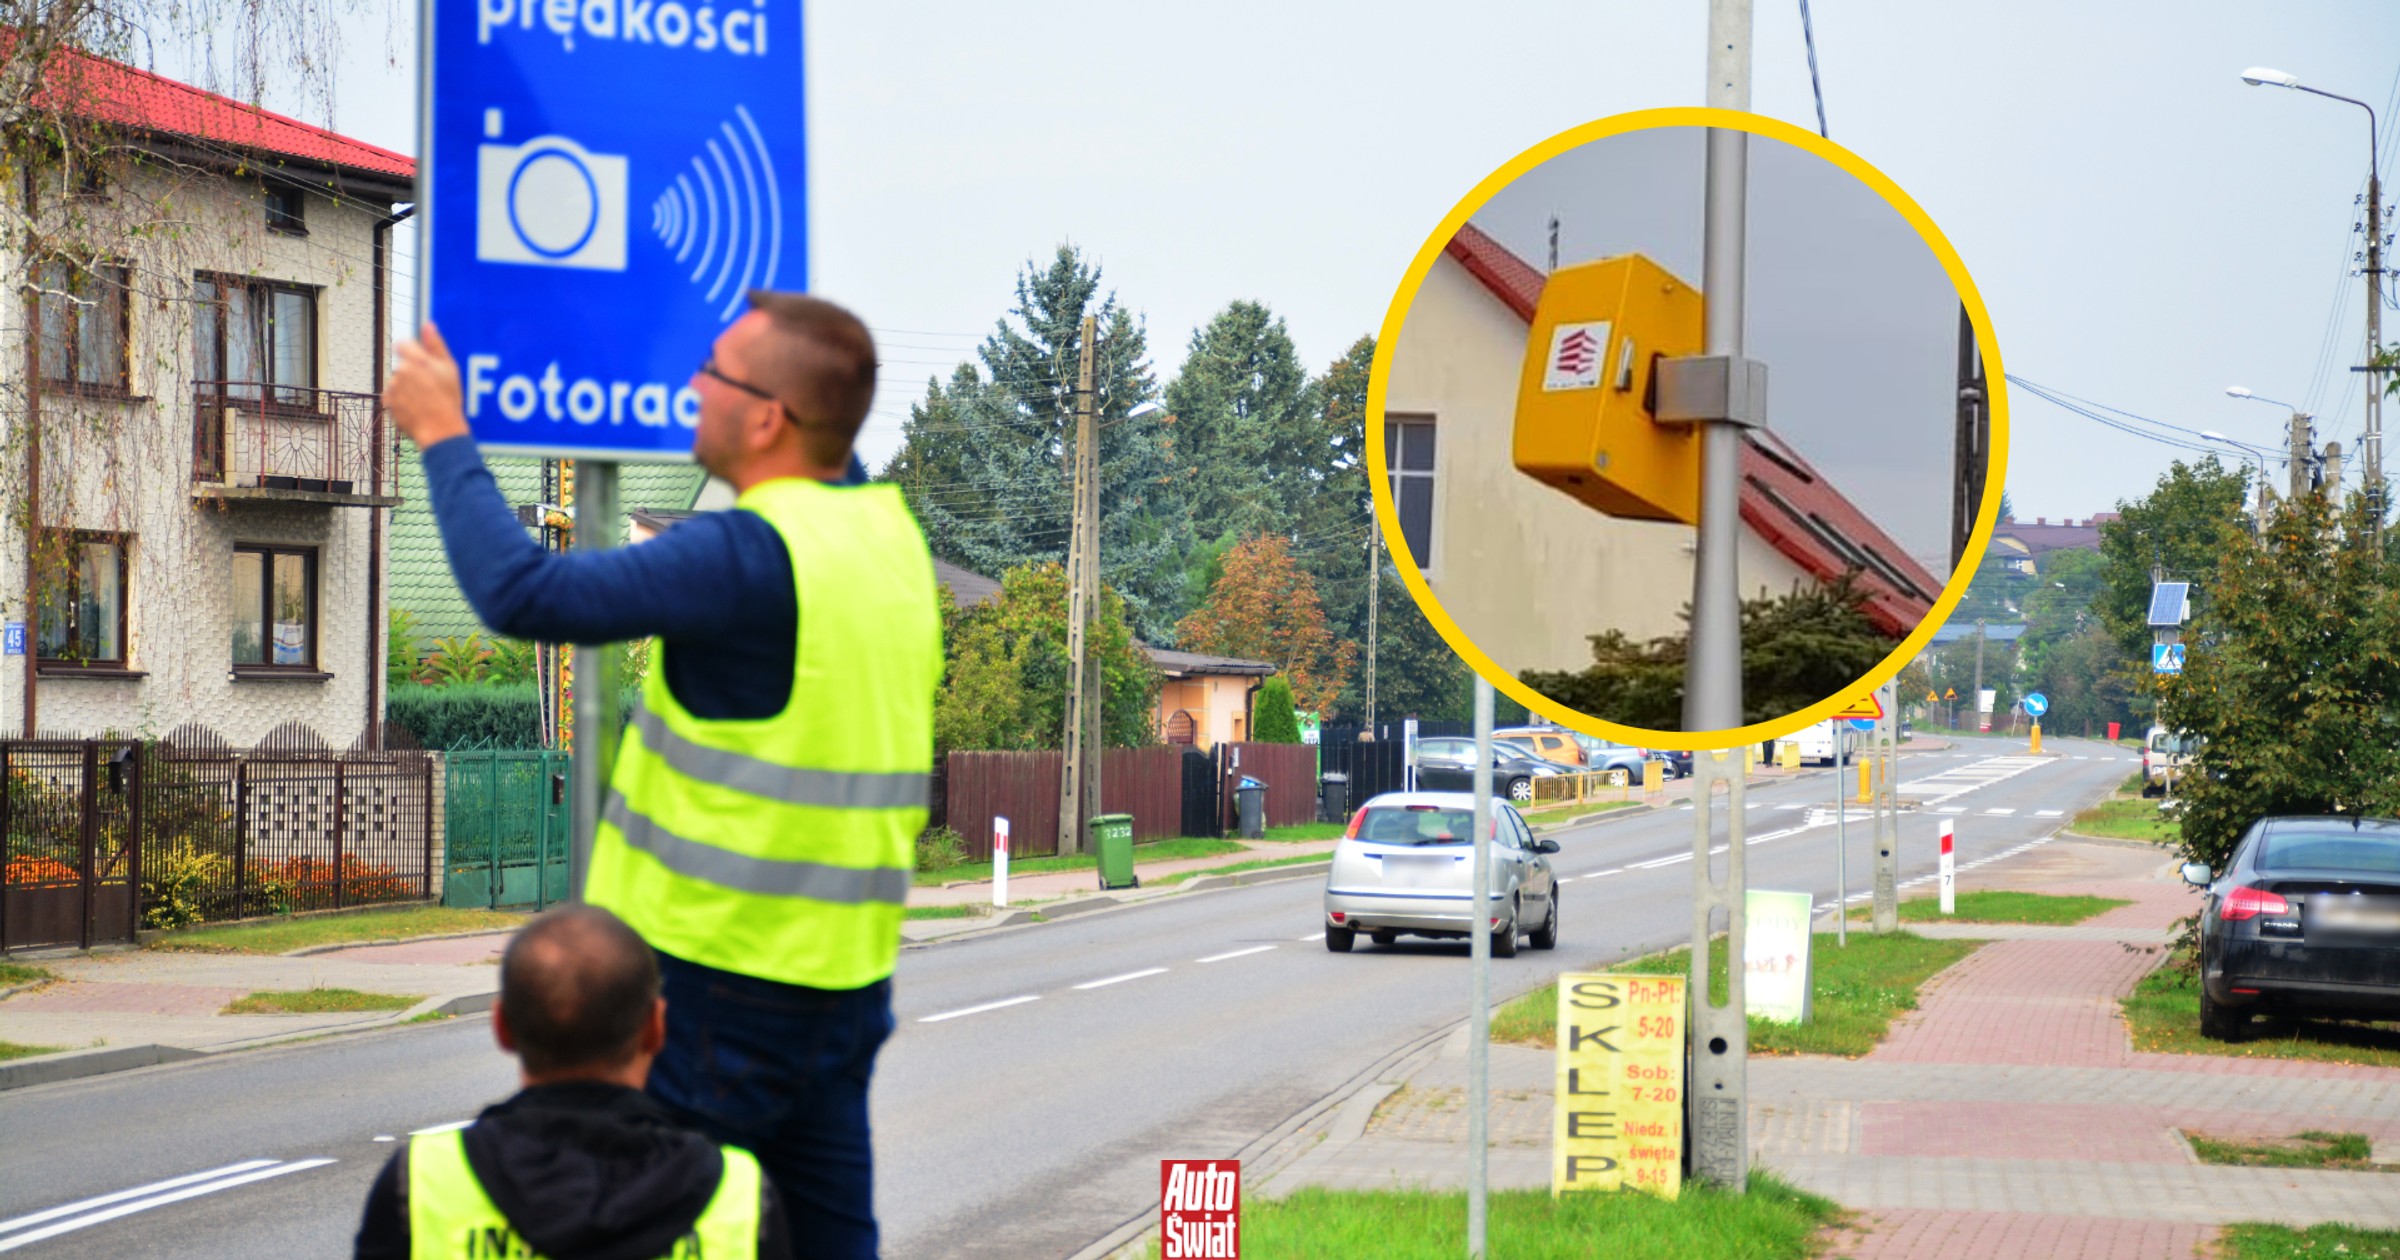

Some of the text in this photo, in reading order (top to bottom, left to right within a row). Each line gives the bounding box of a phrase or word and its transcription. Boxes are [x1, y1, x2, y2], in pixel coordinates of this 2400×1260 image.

[7, 629, 22, 648] 45
[1103, 825, 1133, 840] 3232
[1944, 874, 1952, 886] 7
[1627, 980, 1681, 1005] Pn-Pt:
[1638, 1016, 1675, 1039] 5-20
[1626, 1064, 1676, 1081] Sob:
[1566, 982, 1623, 1182] SKLEP
[1631, 1087, 1677, 1102] 7-20
[1623, 1121, 1678, 1138] Niedz. i
[1628, 1144, 1676, 1163] święta
[1636, 1168, 1668, 1185] 9-15
